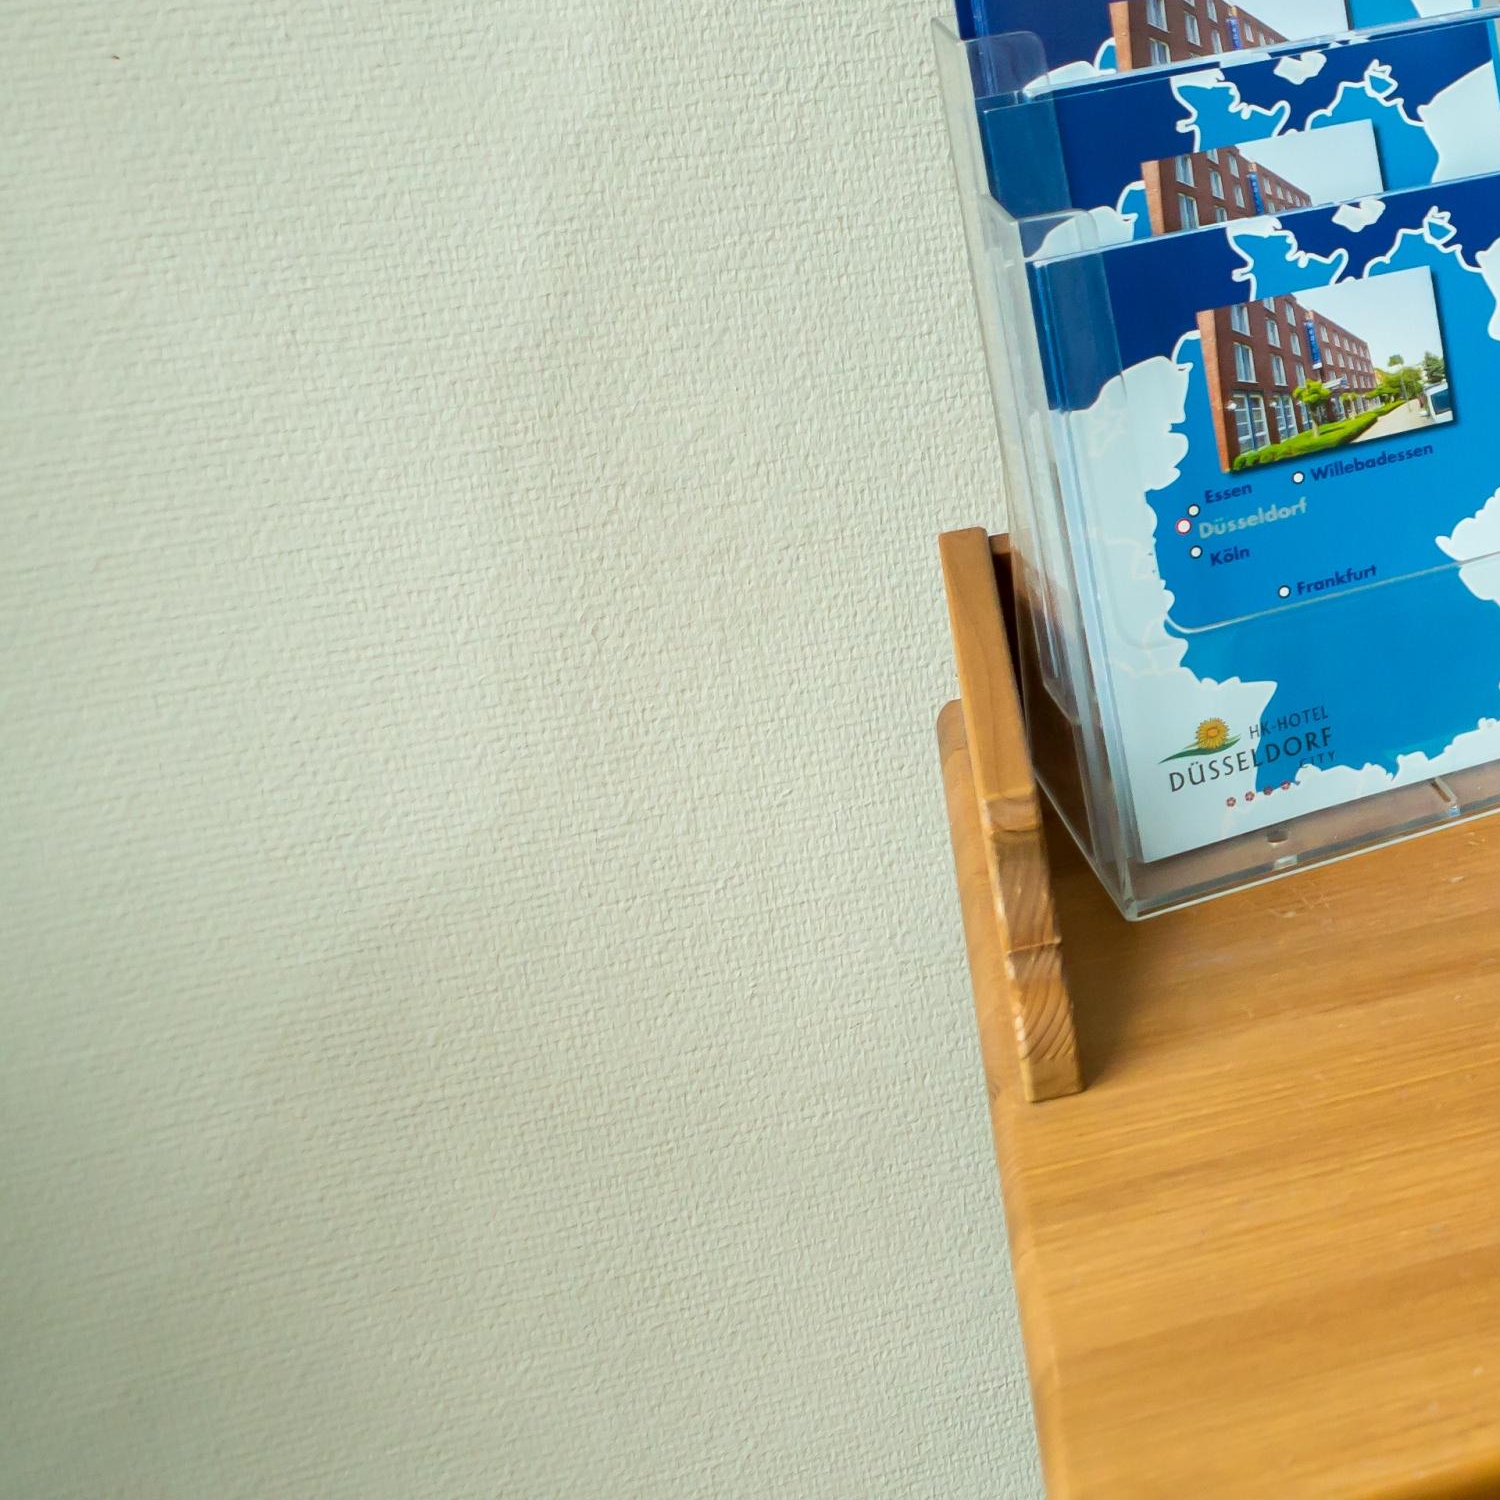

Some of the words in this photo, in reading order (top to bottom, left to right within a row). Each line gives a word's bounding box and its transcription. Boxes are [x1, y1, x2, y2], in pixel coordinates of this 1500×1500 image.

[1310, 444, 1434, 481] Willebadessen
[1204, 483, 1253, 505] Essen
[1198, 496, 1308, 540] Düsseldorf
[1210, 546, 1251, 567] Köln
[1297, 564, 1377, 596] Frankfurt
[1249, 705, 1329, 739] HK-HOTEL
[1169, 727, 1332, 793] DÜSSELDORF
[1299, 751, 1336, 769] CITY
